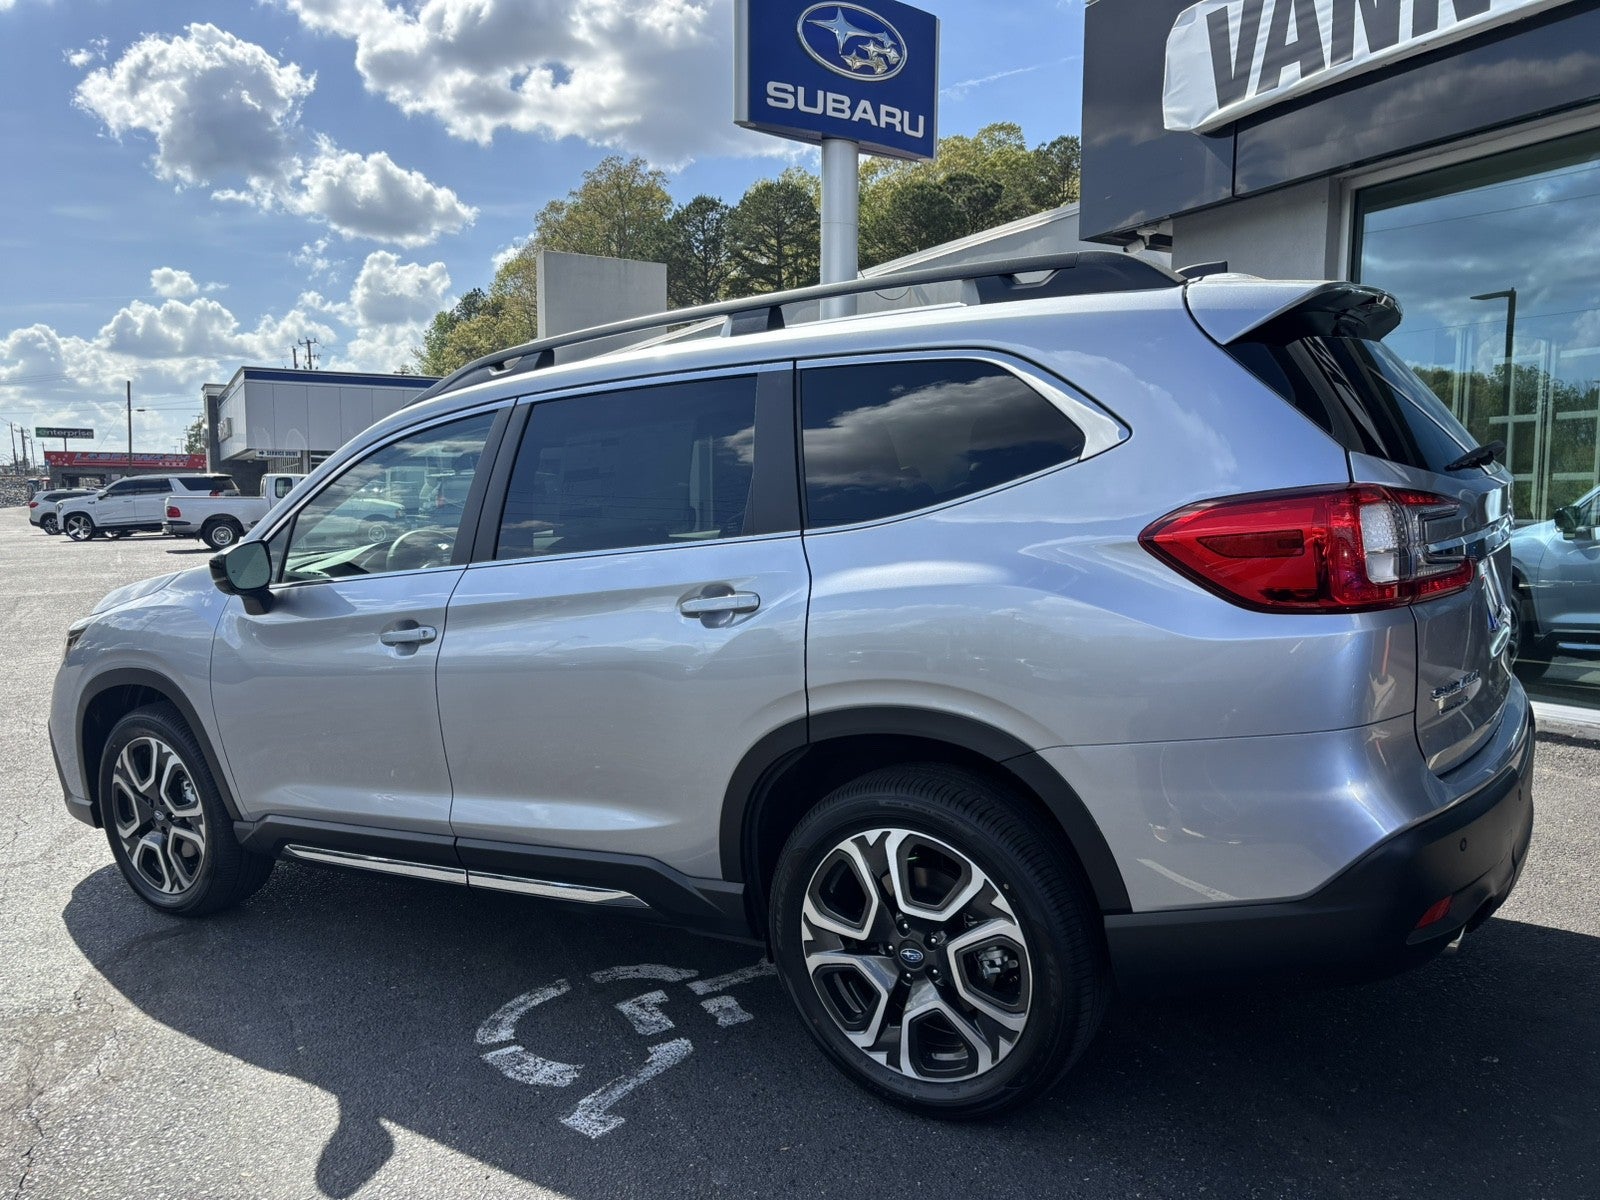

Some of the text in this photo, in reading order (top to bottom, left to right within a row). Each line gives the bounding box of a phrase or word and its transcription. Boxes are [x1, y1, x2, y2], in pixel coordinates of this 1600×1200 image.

[1206, 0, 1492, 109] VAN
[766, 80, 925, 138] SUBARU
[38, 429, 93, 437] enterprise
